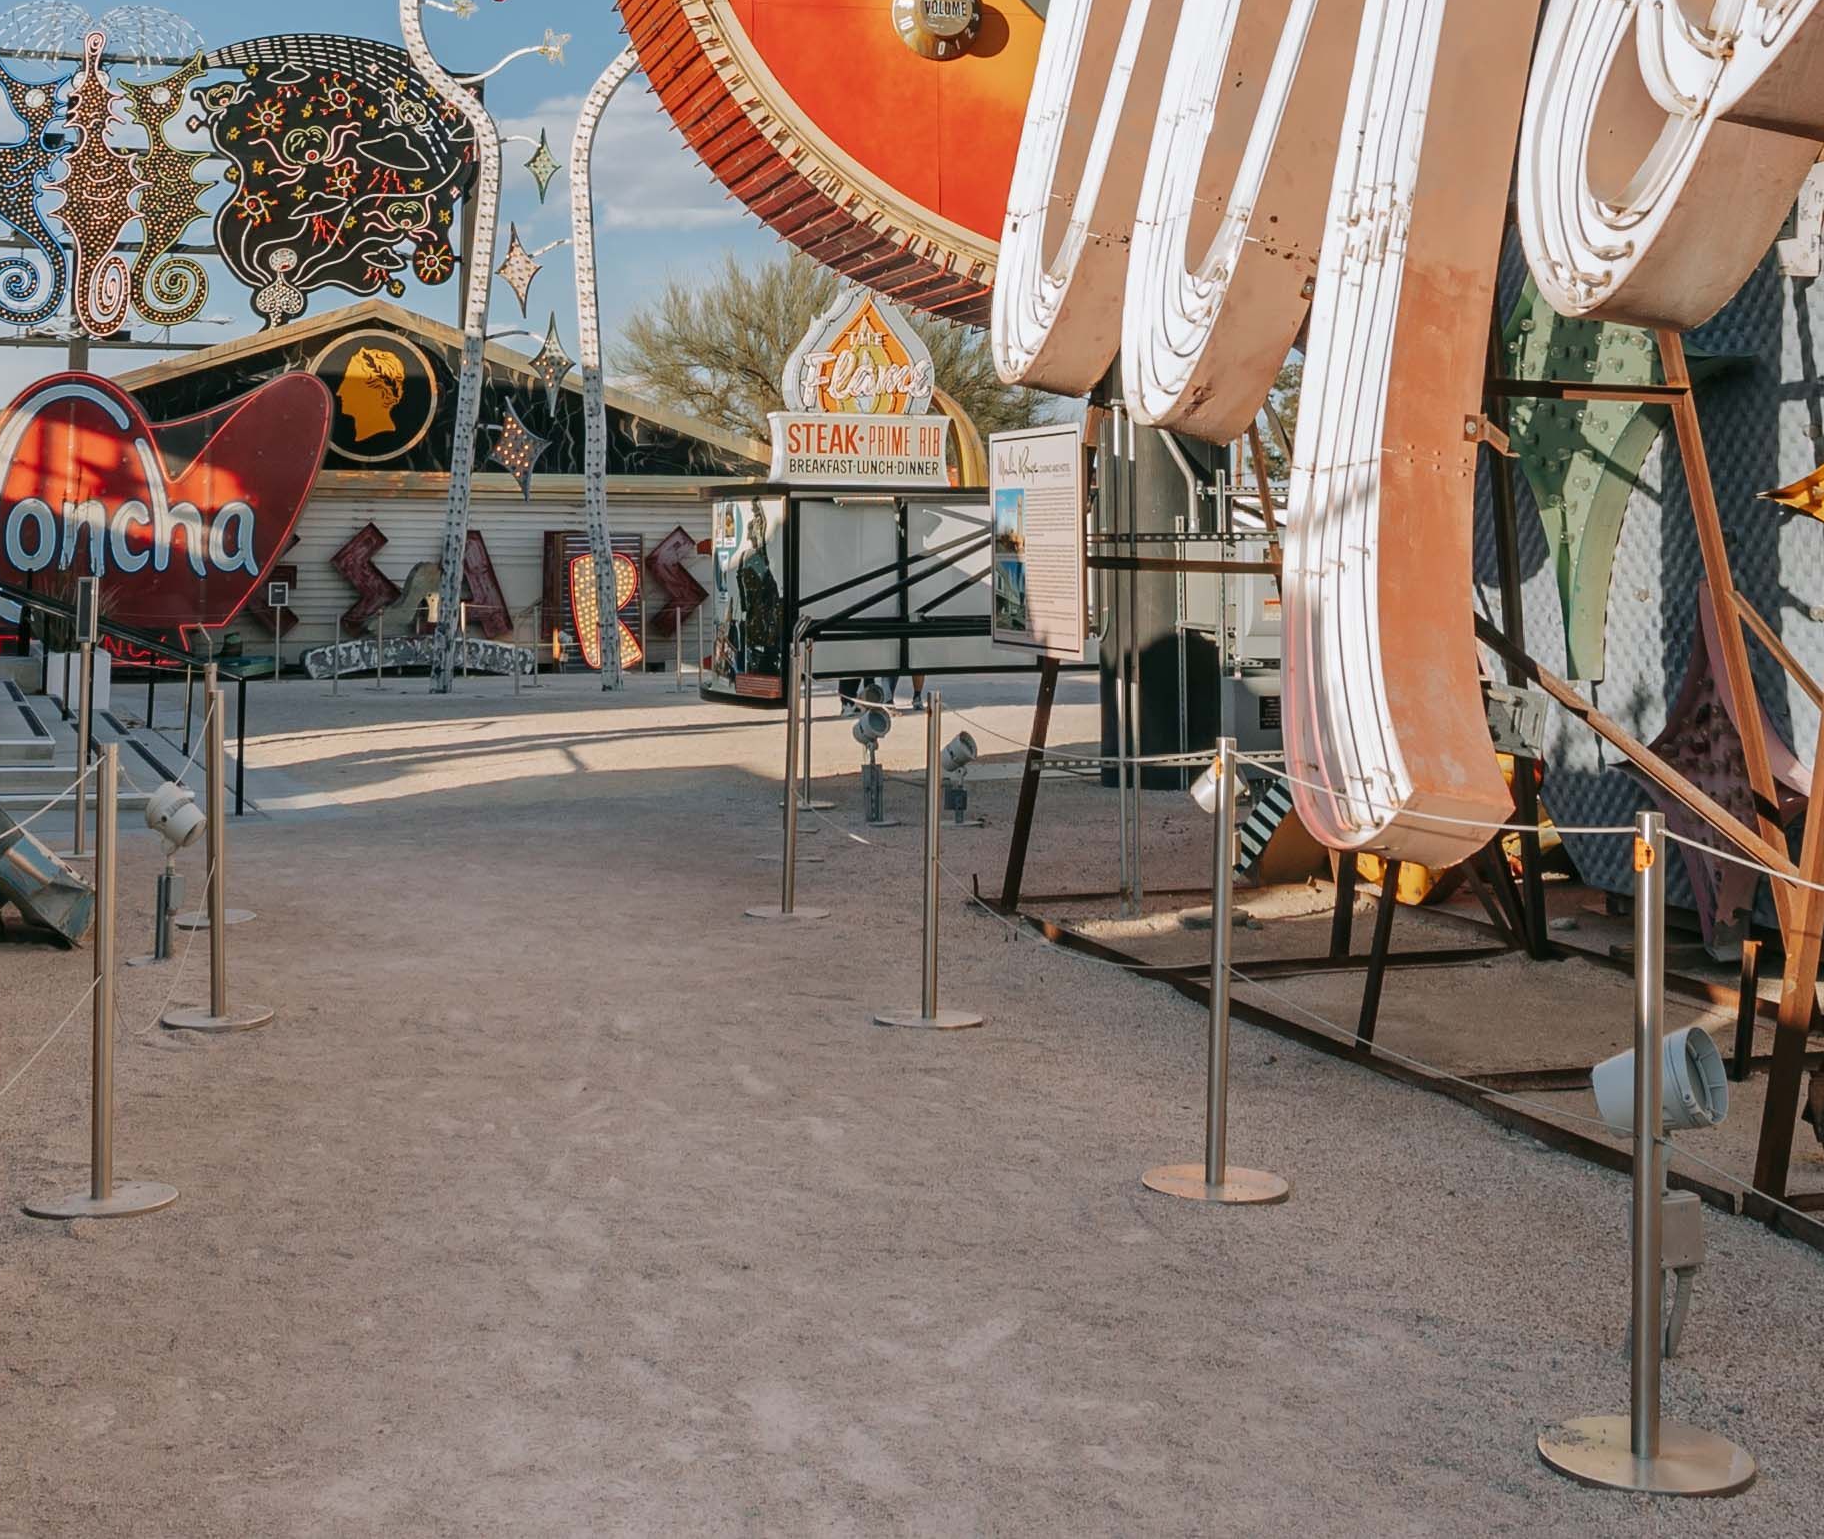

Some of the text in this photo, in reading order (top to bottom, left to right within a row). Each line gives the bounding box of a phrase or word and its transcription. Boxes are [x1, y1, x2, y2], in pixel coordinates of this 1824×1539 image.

[925, 0, 967, 15] VOLUME
[848, 331, 885, 346] THE
[800, 348, 933, 407] Flame
[869, 424, 911, 457] PRIME
[919, 426, 941, 457] RIB
